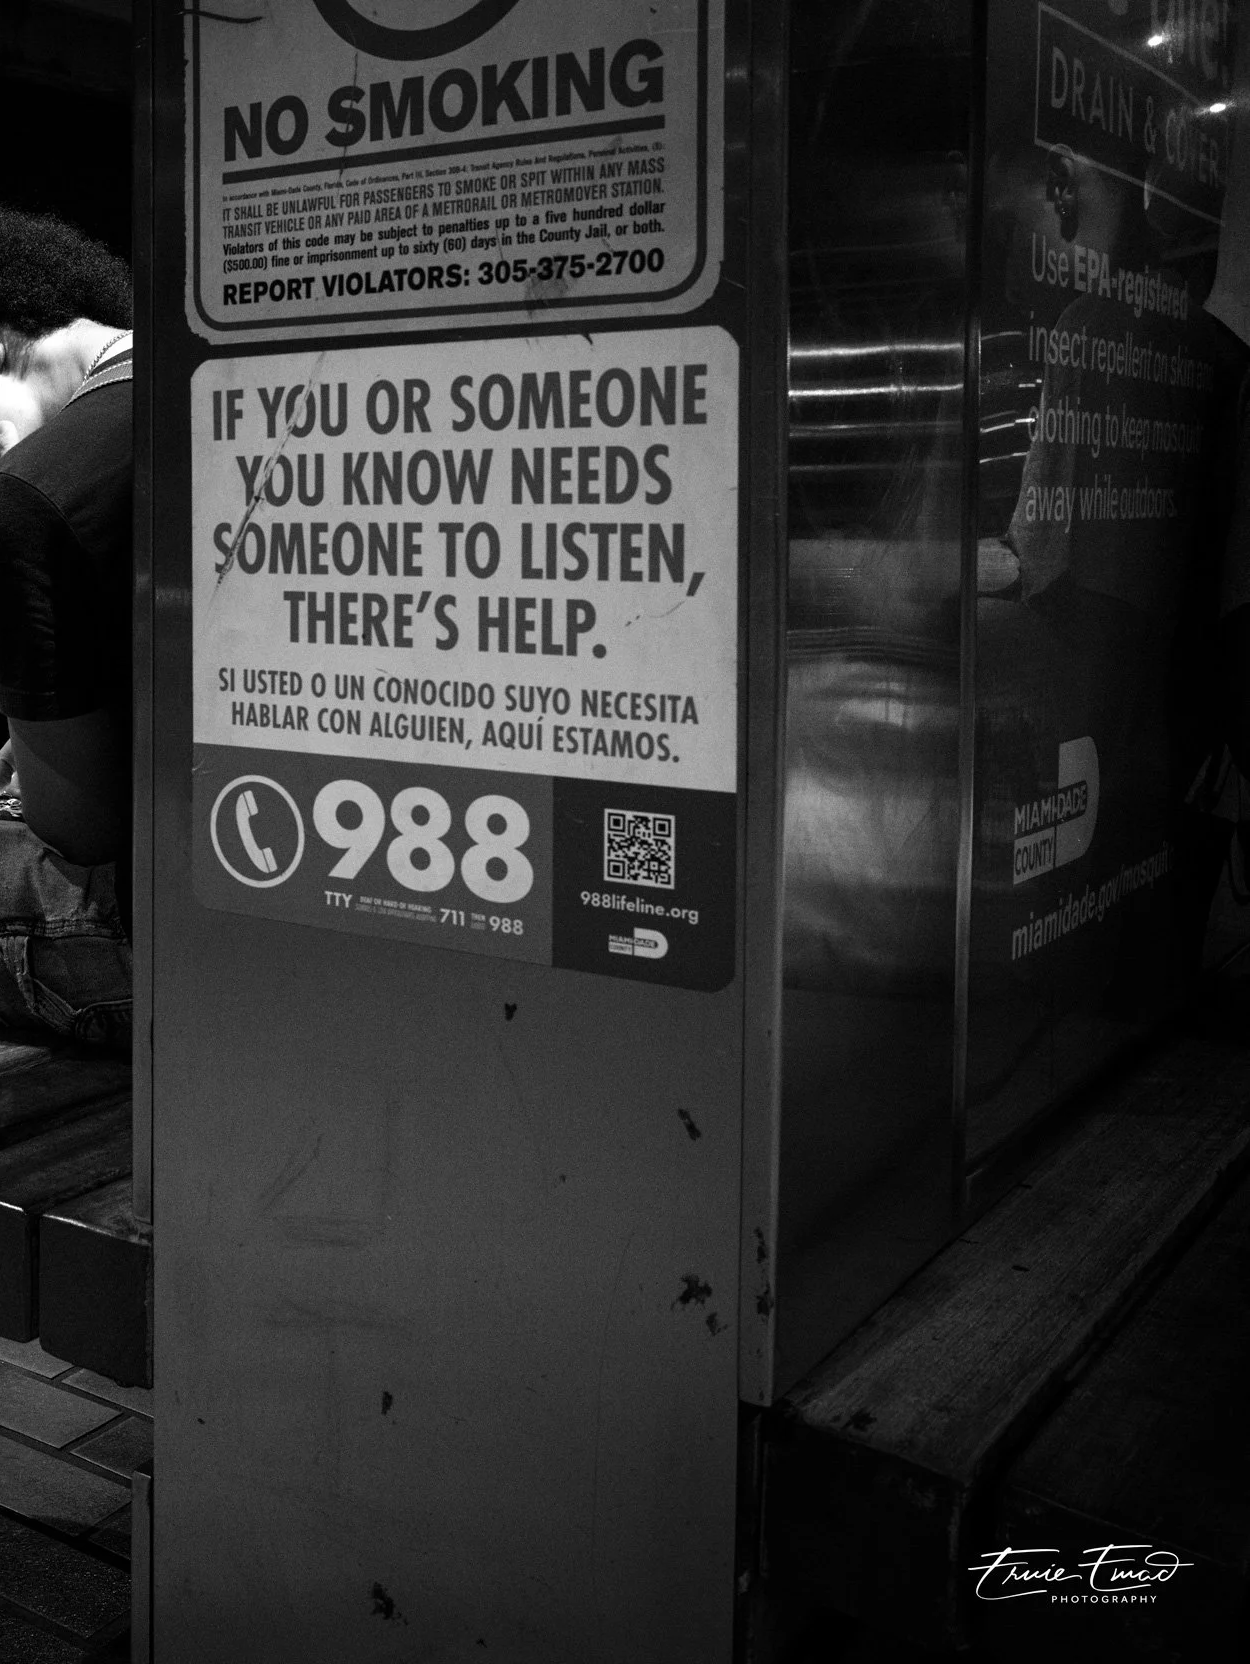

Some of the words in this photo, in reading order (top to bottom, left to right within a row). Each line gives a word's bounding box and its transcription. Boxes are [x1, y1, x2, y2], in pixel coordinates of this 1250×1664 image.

[224, 95, 309, 162] NO
[324, 38, 665, 148] SMOKING
[1051, 46, 1133, 145] DRAIN
[1144, 95, 1156, 154] &
[223, 208, 233, 222] IT
[234, 203, 263, 221] SHALL
[266, 202, 279, 217] BE
[282, 195, 335, 215] UNLAWFUL
[339, 192, 360, 209] FOR
[363, 182, 434, 206] PASSENGERS
[438, 182, 452, 197] TO
[455, 176, 497, 196] SMOKE
[500, 174, 517, 190] OR
[520, 170, 547, 188] SPIT
[551, 165, 595, 185] WITHIN
[599, 162, 623, 179] ANY
[627, 157, 665, 177] MASS
[223, 222, 262, 240] TRANSIT
[265, 217, 305, 235] VEHICLE
[308, 215, 322, 230] OR
[324, 213, 345, 228] ANY
[348, 210, 371, 226] PAID
[374, 206, 402, 224] AREA
[405, 204, 420, 220] OF
[422, 203, 431, 218] A
[432, 196, 498, 217] METRORAIL
[501, 194, 518, 209] OR
[520, 184, 607, 208] METROMOVER
[611, 178, 665, 198] STATION.
[223, 241, 264, 256] Violators
[268, 239, 278, 251] of
[282, 236, 301, 250] this
[305, 234, 329, 248] code
[334, 233, 356, 246] may
[360, 228, 373, 243] be
[377, 225, 417, 242] subject
[422, 224, 433, 236] to
[438, 217, 489, 236] penalties
[495, 217, 509, 231] up
[515, 213, 527, 226] to
[532, 214, 540, 225] a
[545, 210, 567, 224] five
[572, 203, 623, 222] hundred
[629, 200, 666, 216] dollar
[223, 257, 268, 274] ($500.00)
[271, 255, 290, 268] fine
[293, 254, 303, 265] or
[307, 246, 378, 267] imprisonment
[381, 246, 395, 260] up
[399, 243, 409, 256] to
[413, 239, 439, 255] sixty
[443, 237, 467, 253] (60)
[471, 234, 497, 251] days
[501, 232, 513, 246] in
[516, 230, 535, 244] the
[539, 226, 581, 244] County
[585, 224, 611, 240] Jail,
[615, 225, 628, 237] or
[633, 219, 665, 234] both.
[223, 276, 315, 306] REPORT
[322, 263, 469, 297] VIOLATORS:
[478, 248, 665, 286] 305-375-2700
[1032, 232, 1069, 288] Use
[1074, 245, 1189, 321] EPA-registered
[1029, 311, 1087, 370] insect
[1091, 331, 1154, 385] repellent
[1154, 351, 1168, 383] on
[1169, 345, 1194, 389] skin
[213, 389, 244, 441] IF
[257, 382, 348, 439] YOU
[366, 378, 432, 435] OR
[451, 363, 708, 432] SOMEONE
[1028, 396, 1101, 459] clothing
[1105, 405, 1119, 448] to
[1122, 403, 1150, 461] keep
[236, 453, 324, 507] YOU
[343, 448, 493, 506] KNOW
[511, 443, 673, 505] NEEDS
[1025, 485, 1076, 534] away
[1080, 474, 1118, 521] while
[213, 521, 423, 577] SOMEONE
[438, 521, 501, 580] TO
[521, 521, 706, 597] LISTEN,
[478, 596, 607, 660] HELP.
[219, 667, 235, 693] SI
[243, 669, 303, 696] USTED
[311, 672, 327, 698] O
[335, 674, 365, 701] UN
[373, 676, 495, 710] CONOCIDO
[504, 684, 571, 716] SUYO
[581, 689, 699, 725] NECESITA
[231, 701, 309, 731] HABLAR
[317, 708, 361, 736] CON
[369, 711, 472, 750] ALGUIEN,
[481, 715, 543, 751] AQUÍ
[552, 724, 680, 763] ESTAMOS.
[312, 779, 534, 903] 988
[1014, 836, 1055, 877] COUNTY
[324, 890, 353, 908] TTY
[439, 907, 465, 927] 711
[489, 915, 524, 936] 988
[580, 890, 699, 925] 988lifeline.org
